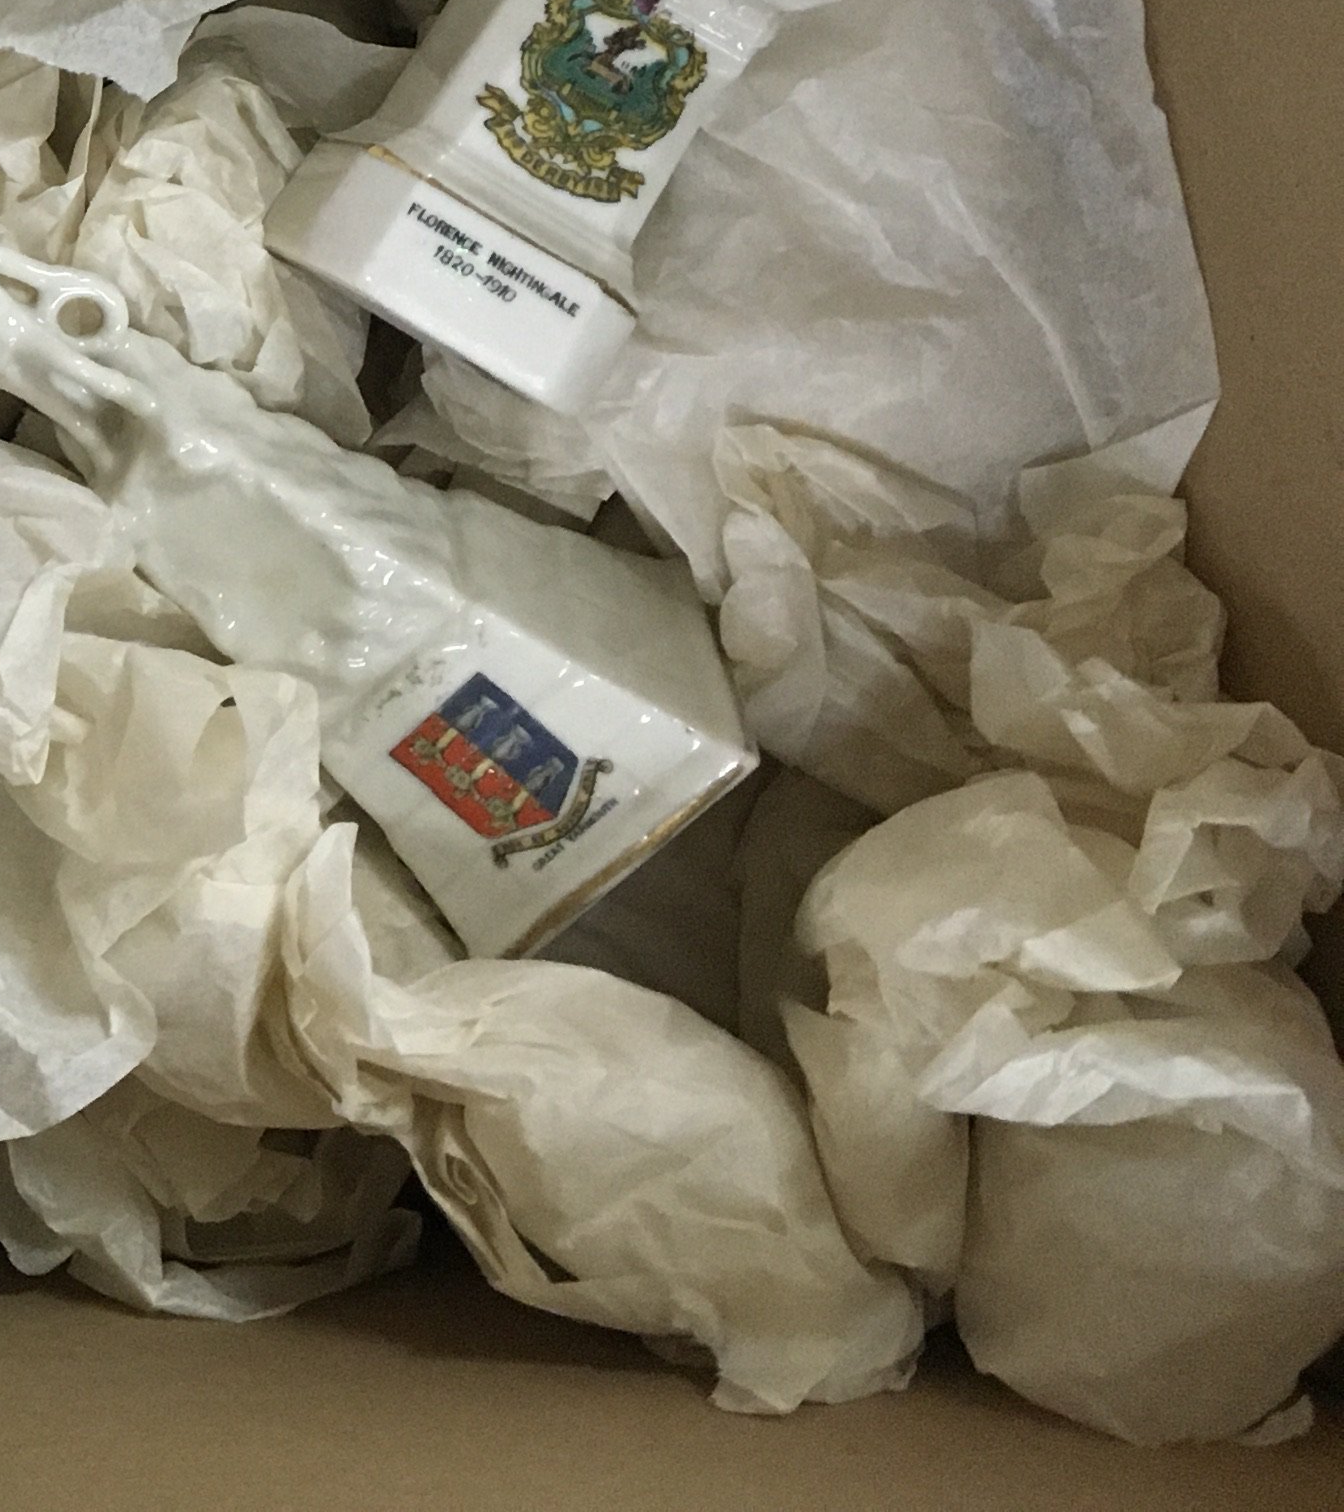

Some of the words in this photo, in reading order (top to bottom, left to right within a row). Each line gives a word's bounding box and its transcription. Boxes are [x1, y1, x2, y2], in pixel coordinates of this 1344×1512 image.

[407, 202, 483, 256] FLORENCE
[487, 251, 580, 318] NIGHTINGALE
[433, 245, 518, 303] 1820-1910
